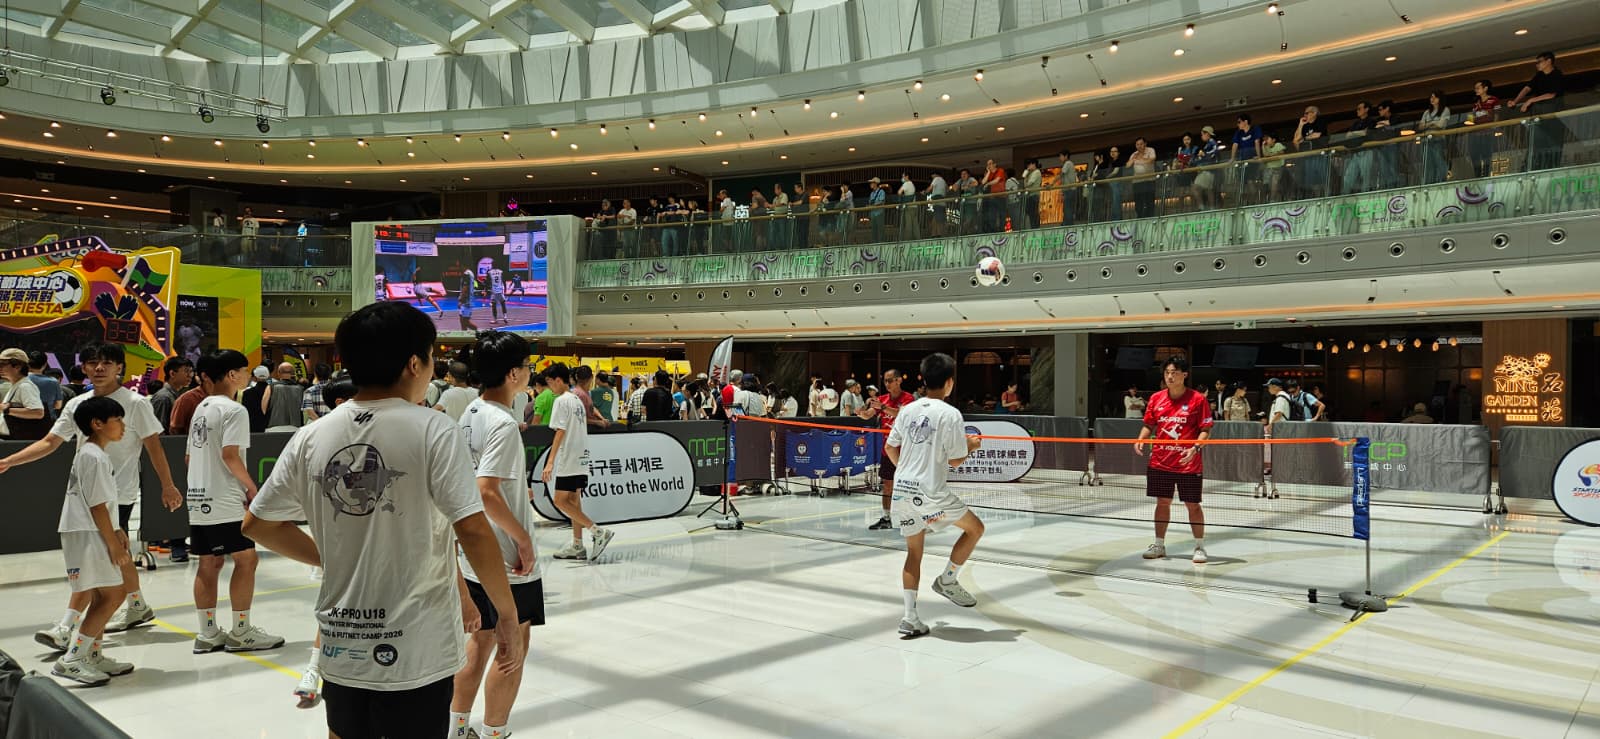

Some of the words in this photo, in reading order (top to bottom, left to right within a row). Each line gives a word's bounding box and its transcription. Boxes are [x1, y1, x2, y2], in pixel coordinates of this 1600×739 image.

[12, 303, 63, 313] FIESTA
[1496, 380, 1538, 392] MING
[1485, 395, 1538, 406] GARDEN
[625, 457, 664, 473] 세계로
[610, 483, 624, 495] to
[626, 480, 647, 494] the
[649, 476, 685, 492] World
[363, 608, 386, 619] U18
